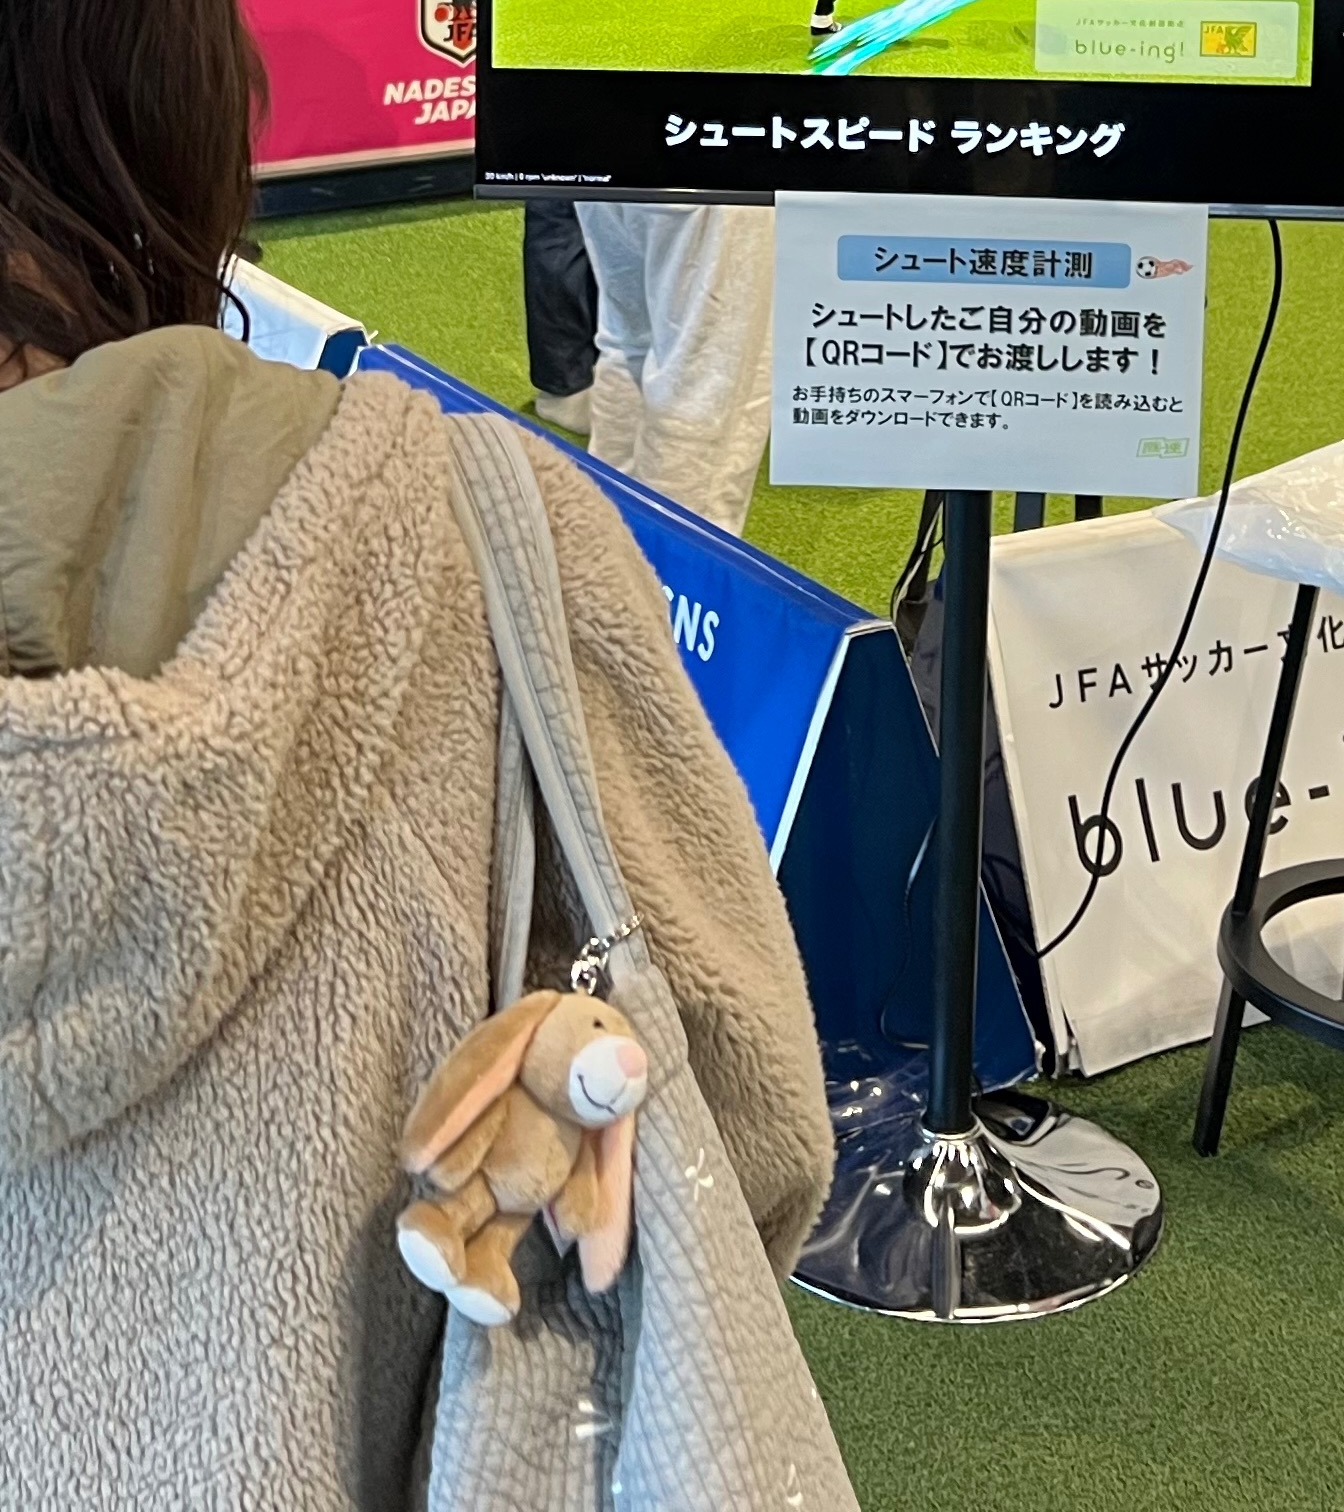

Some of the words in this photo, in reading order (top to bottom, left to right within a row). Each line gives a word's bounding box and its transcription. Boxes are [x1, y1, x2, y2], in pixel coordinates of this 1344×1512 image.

[1203, 25, 1224, 35] JFA
[1075, 40, 1184, 64] blue-ing!
[664, 114, 934, 153] シュートスピード
[951, 120, 1126, 158] ランキング
[873, 245, 1093, 279] シュート速度計測
[811, 302, 1167, 339] シュートしたご自分の動画を
[792, 407, 1009, 430] 動画をダウンロードできます。
[662, 585, 720, 662] NS
